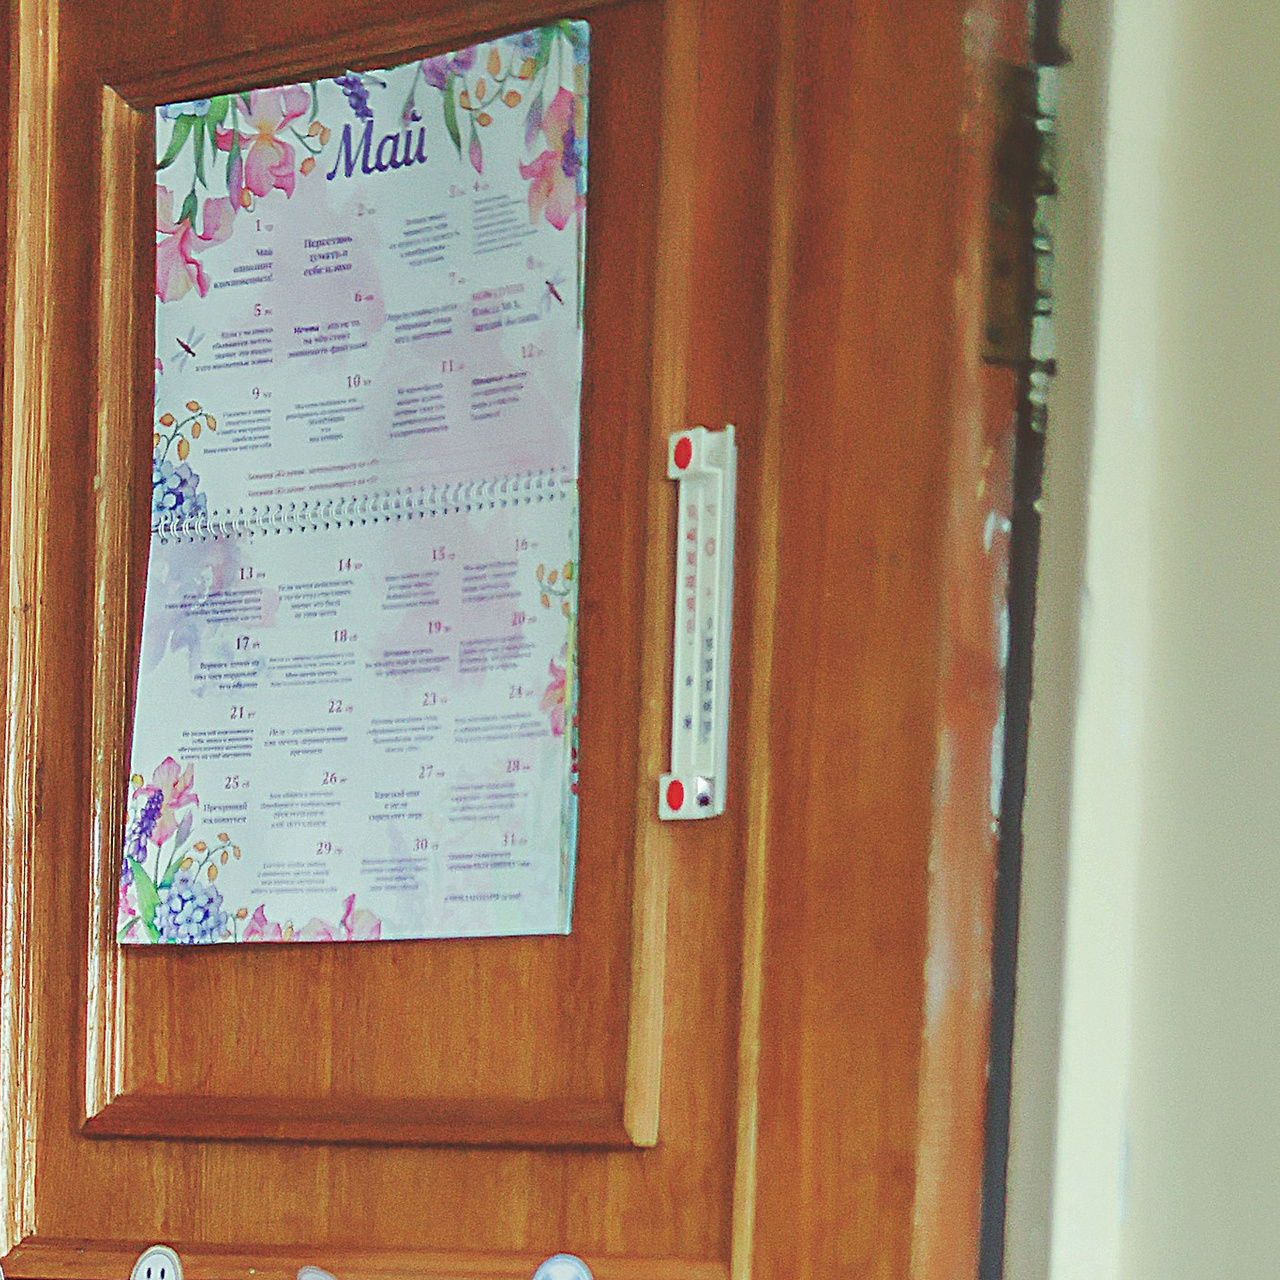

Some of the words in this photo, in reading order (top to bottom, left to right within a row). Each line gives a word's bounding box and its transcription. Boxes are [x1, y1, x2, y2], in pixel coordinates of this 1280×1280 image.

[326, 109, 428, 181] Май
[347, 374, 361, 389] 10
[431, 545, 445, 562] 15
[339, 558, 352, 572] 14
[240, 566, 253, 580] 13
[428, 620, 442, 635] 19
[236, 636, 250, 650] 17
[334, 629, 348, 643] 18
[328, 699, 343, 714] 22
[422, 691, 437, 707] 23
[230, 705, 245, 720] 21
[322, 771, 338, 786] 26
[419, 763, 434, 780] 27
[224, 775, 240, 790] 25
[316, 841, 333, 857] 29
[414, 837, 429, 852] 30
